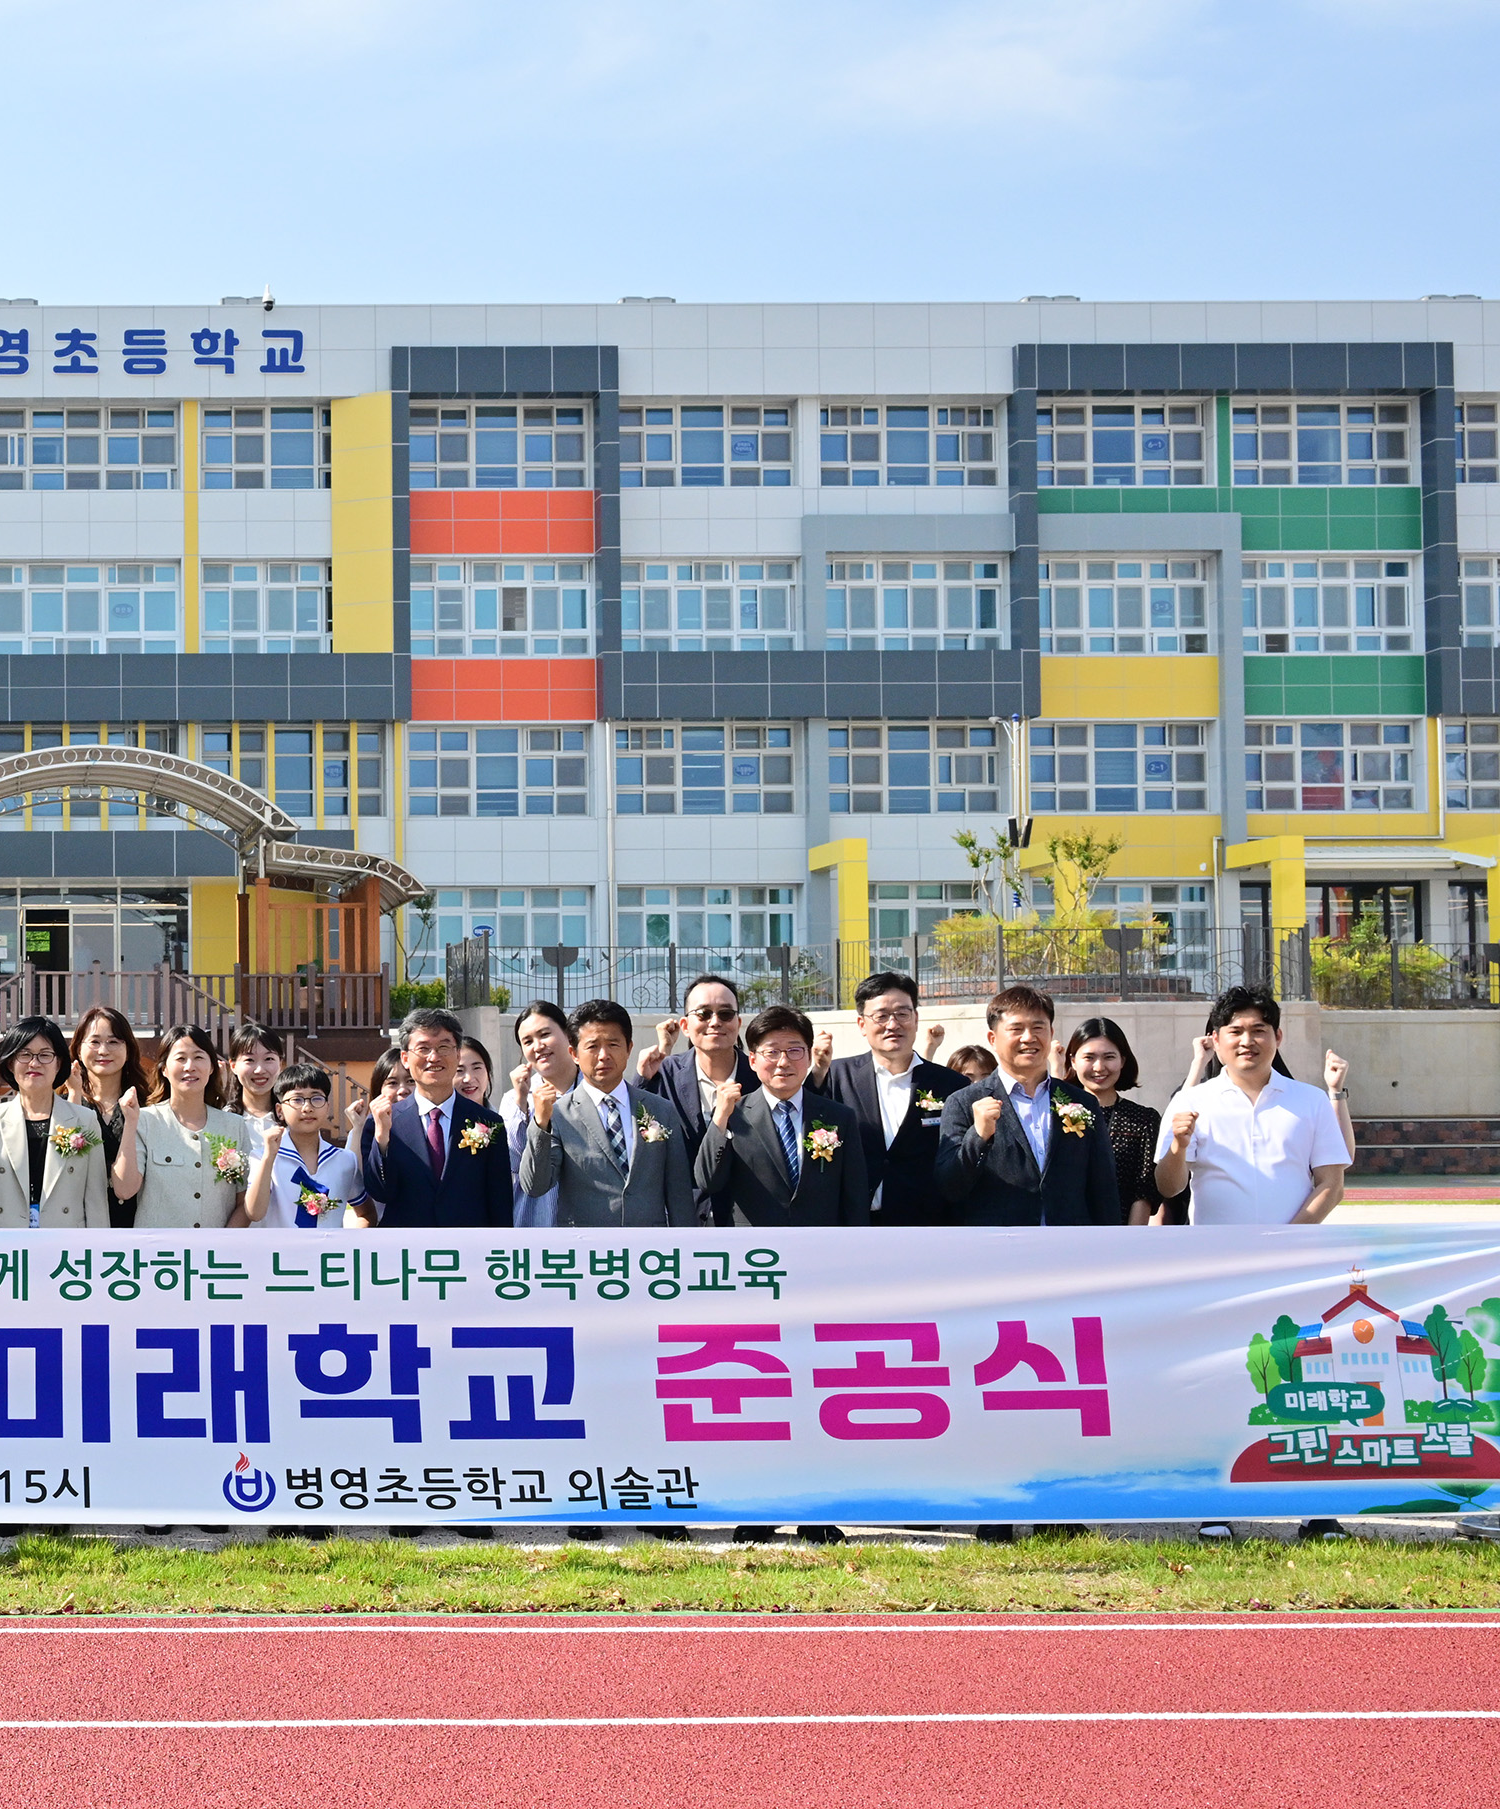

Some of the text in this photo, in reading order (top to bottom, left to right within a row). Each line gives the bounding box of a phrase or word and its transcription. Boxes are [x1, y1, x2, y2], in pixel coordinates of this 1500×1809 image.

[49, 1248, 249, 1302] 성장하는
[265, 1248, 467, 1301] 느티나무
[485, 1248, 788, 1301] 행복병영교육
[655, 1316, 1112, 1442] 준공식
[1284, 1389, 1371, 1413] 미래학교
[1268, 1423, 1474, 1467] 그린 스마트 스쿨
[285, 1466, 700, 1511] 병영초등학교 외솔관
